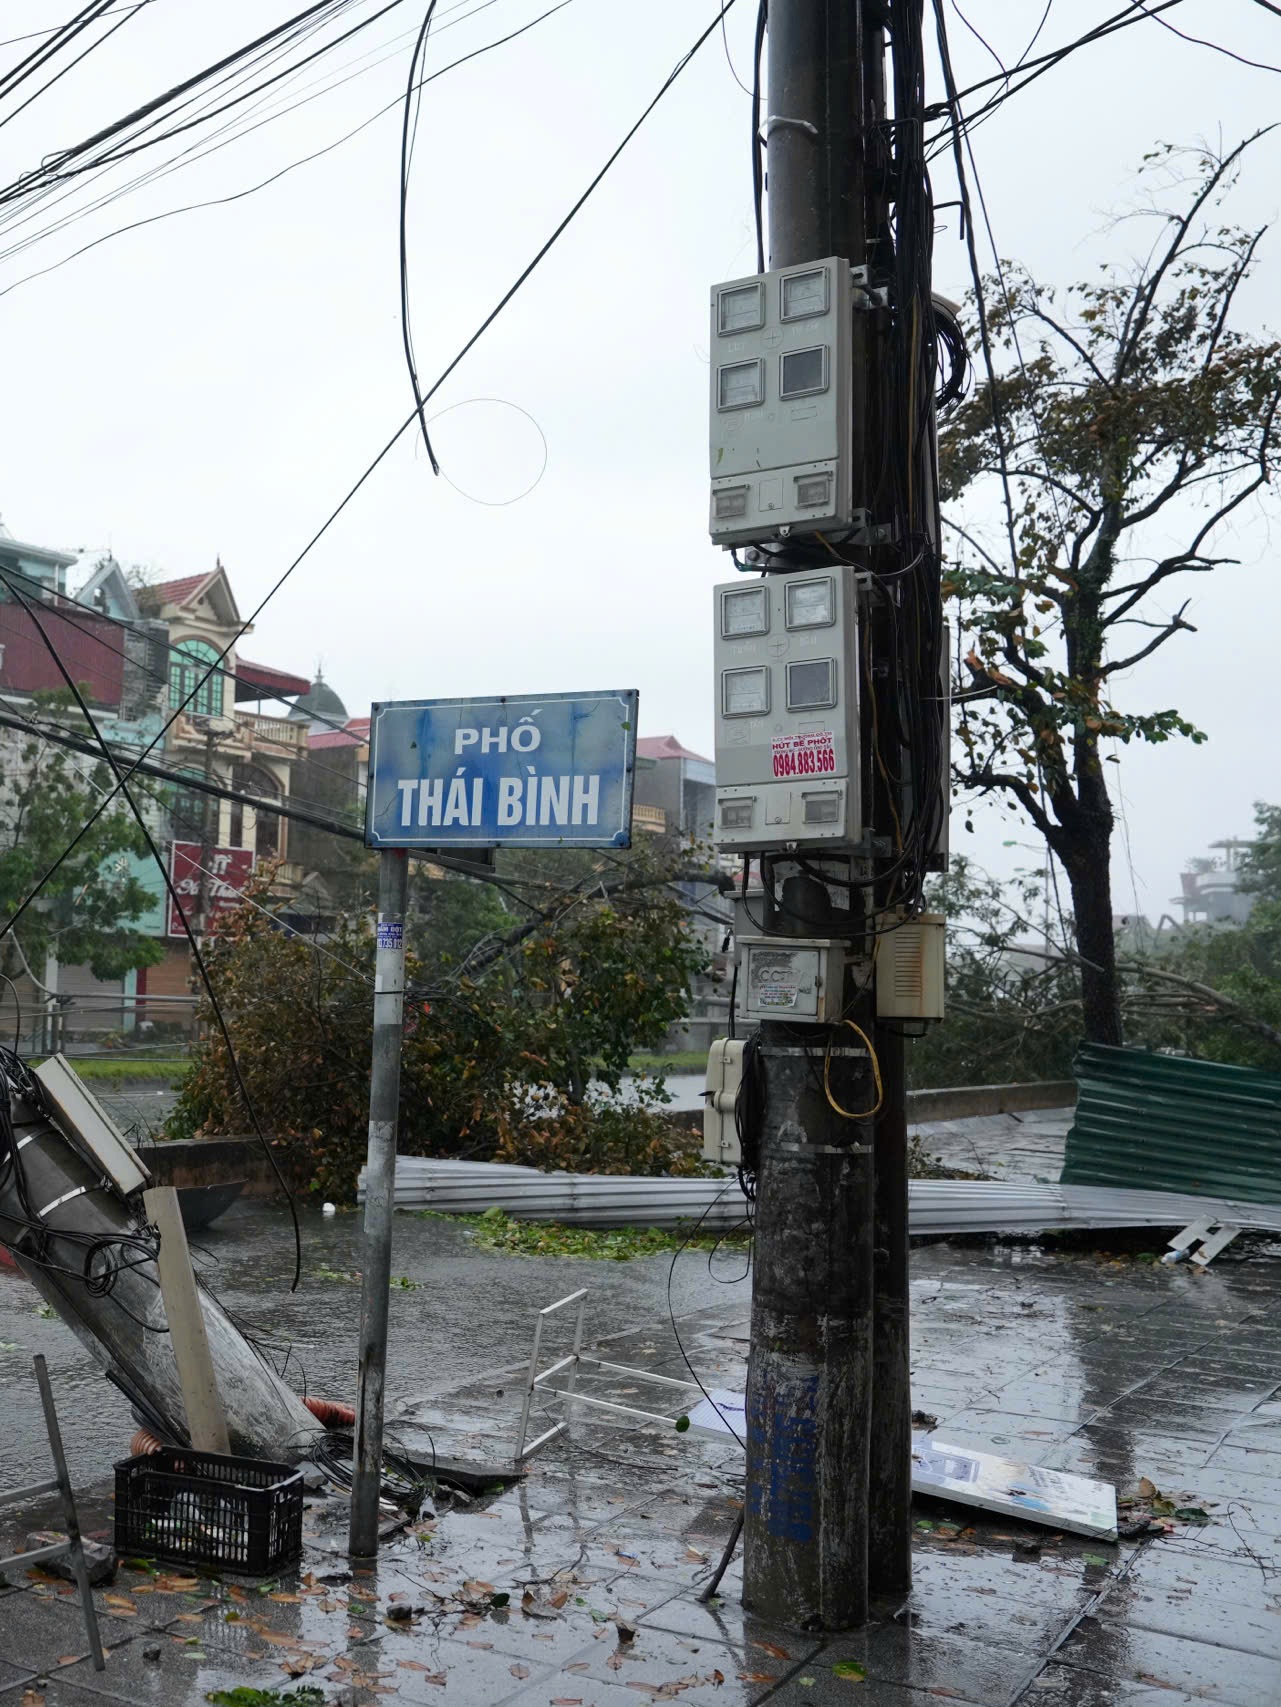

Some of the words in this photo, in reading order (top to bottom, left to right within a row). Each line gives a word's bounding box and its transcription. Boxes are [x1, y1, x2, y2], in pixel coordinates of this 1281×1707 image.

[454, 709, 543, 755] PHỐ
[772, 741, 790, 750] HÚT
[807, 736, 832, 746] PHỐT
[773, 748, 835, 777] 0984.883.566
[398, 767, 483, 826] THÁI
[497, 766, 600, 826] BÌNH
